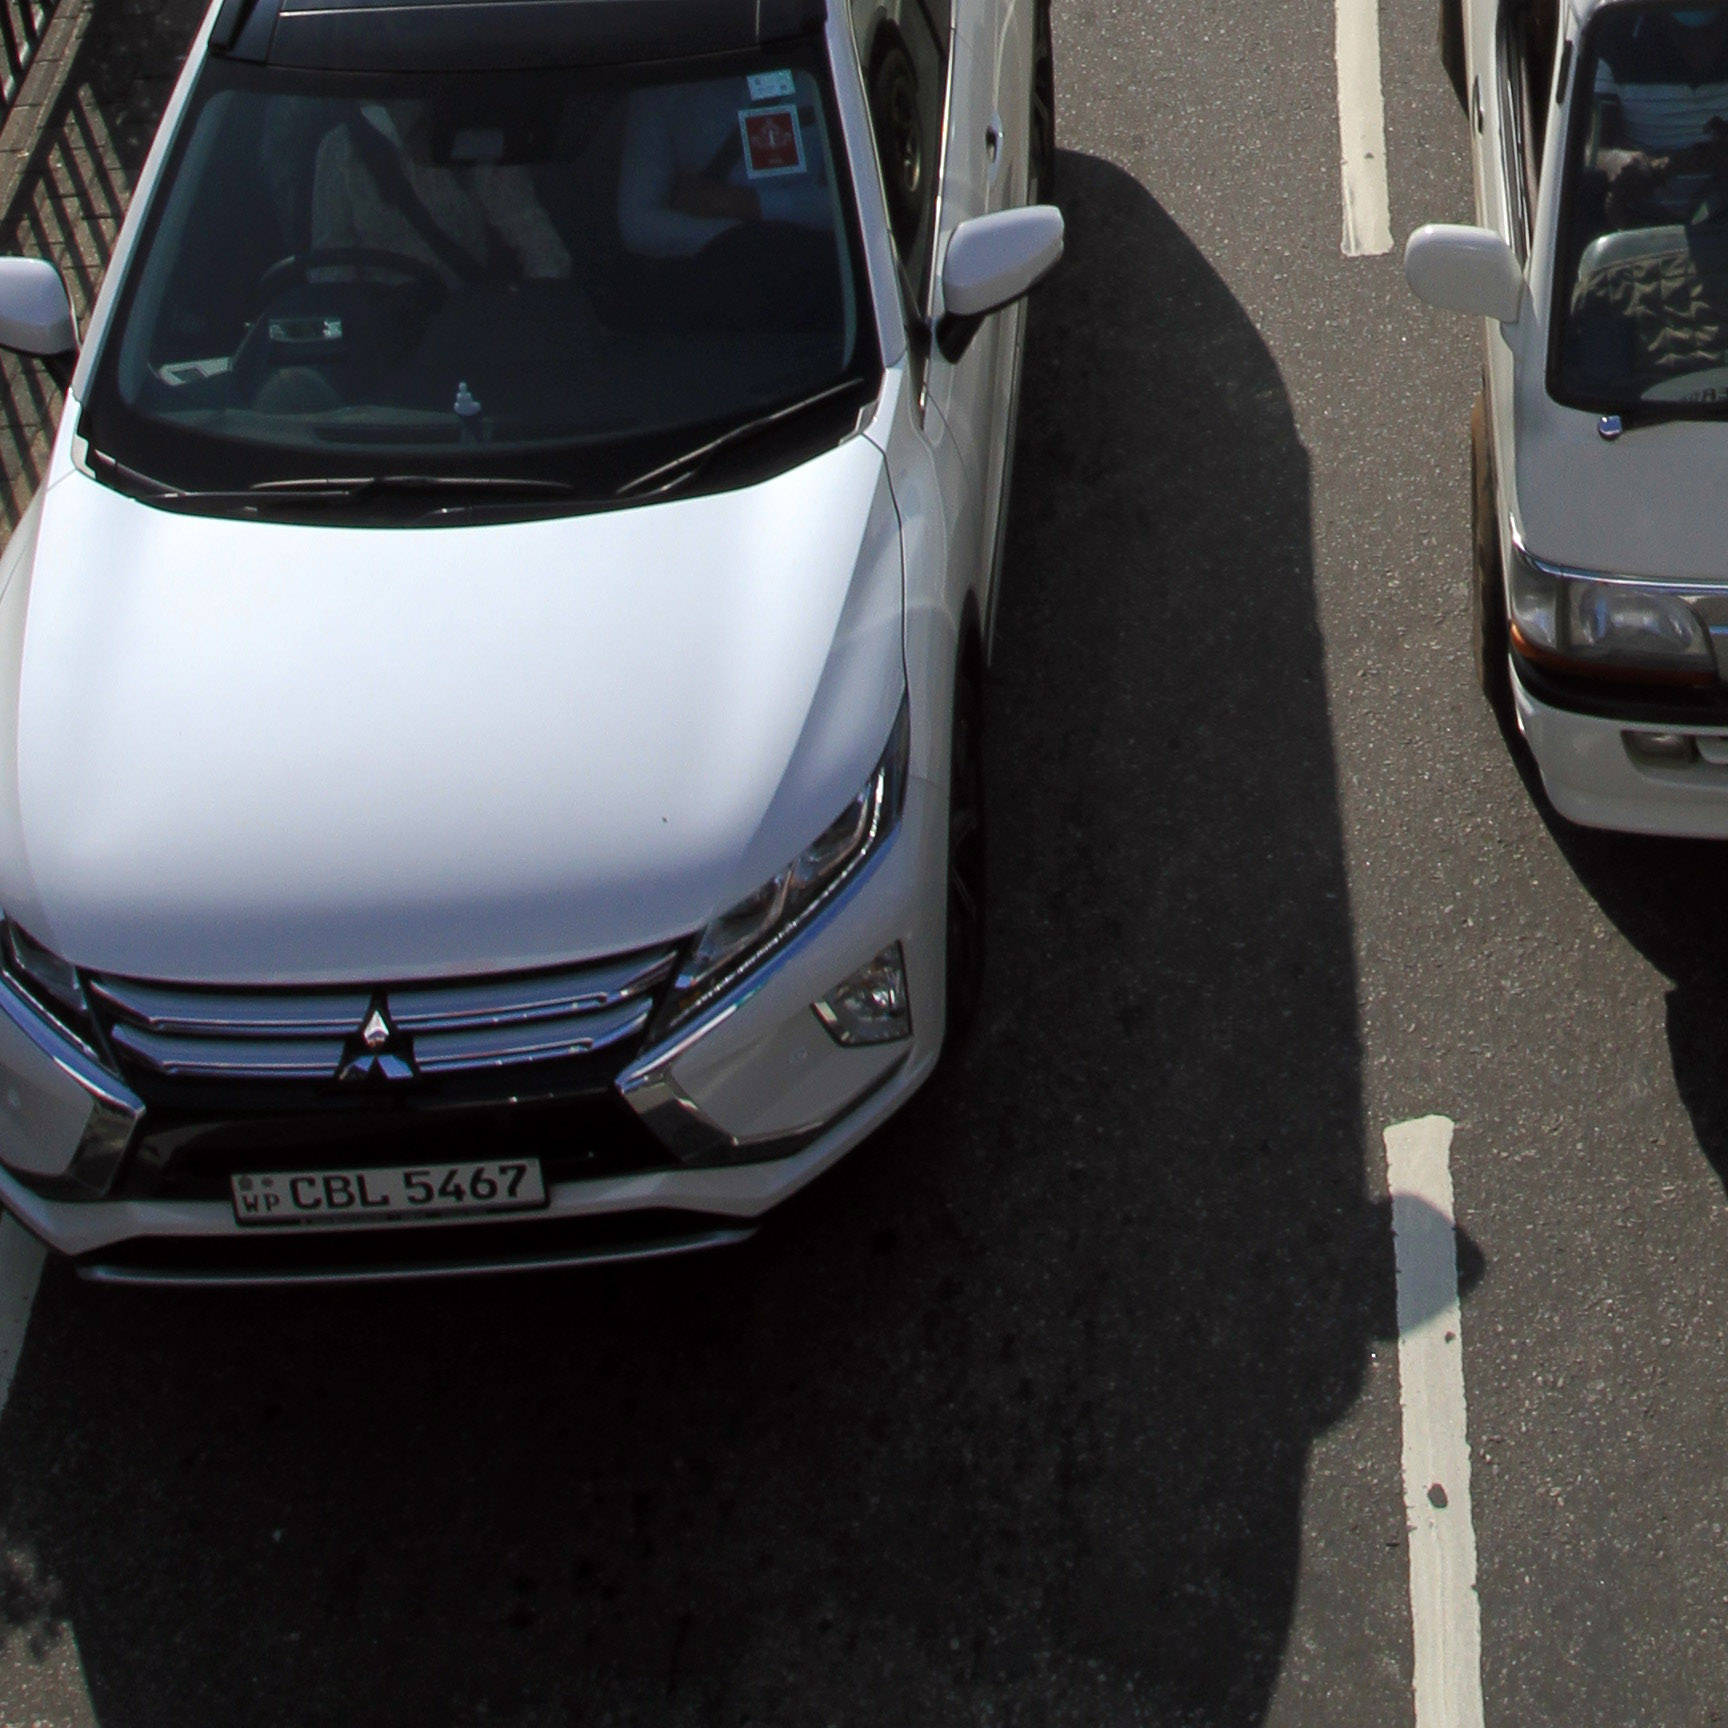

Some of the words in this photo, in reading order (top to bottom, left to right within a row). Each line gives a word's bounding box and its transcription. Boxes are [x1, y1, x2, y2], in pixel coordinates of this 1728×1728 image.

[241, 1192, 281, 1213] WP
[289, 1174, 391, 1211] CBL
[403, 1163, 529, 1206] 5467
